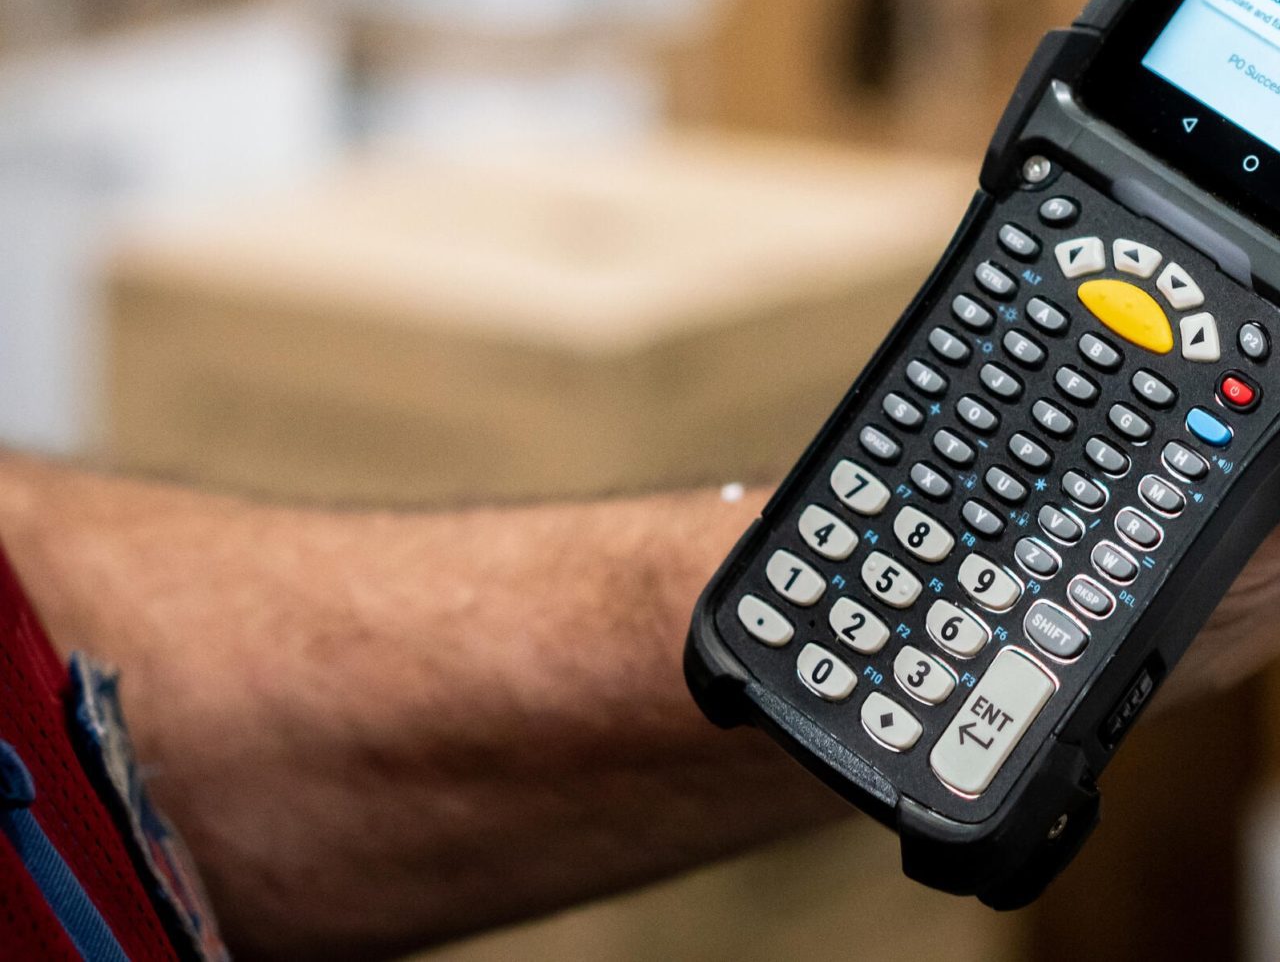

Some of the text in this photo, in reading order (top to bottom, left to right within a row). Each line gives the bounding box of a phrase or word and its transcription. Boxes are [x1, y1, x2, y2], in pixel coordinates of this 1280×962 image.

[1253, 9, 1273, 24] and
[1227, 53, 1247, 70] PO
[1048, 199, 1064, 215] P1
[1006, 231, 1025, 249] ESC
[981, 268, 1003, 289] CTRL
[1021, 269, 1042, 285] ALT
[964, 304, 977, 318] D
[1036, 307, 1050, 323] A
[1014, 339, 1028, 355] E
[1090, 341, 1103, 357] B
[1243, 332, 1259, 349] P2
[917, 369, 932, 386] N
[990, 373, 1005, 388] J
[1066, 375, 1081, 389] F
[1143, 379, 1157, 394] C
[894, 402, 908, 418] S
[1042, 408, 1058, 425] K
[1120, 413, 1133, 428] G
[865, 431, 890, 454] SPACE
[946, 437, 960, 453] T
[1019, 441, 1034, 455] P
[1096, 446, 1107, 462] L
[1173, 449, 1189, 466] H
[844, 473, 870, 499] 7
[921, 470, 937, 488] X
[997, 475, 1011, 491] U
[1073, 479, 1087, 496] Q
[896, 484, 912, 499] F7
[1148, 483, 1166, 502] M
[975, 507, 990, 523] Y
[1050, 512, 1064, 528] V
[813, 523, 836, 547] 4
[907, 521, 931, 549] 8
[1126, 518, 1141, 535] R
[863, 529, 879, 545] F4
[961, 531, 976, 547] F8
[1025, 546, 1041, 563] Z
[1102, 551, 1119, 569] W
[783, 567, 802, 592] 1
[831, 574, 846, 589] F1
[875, 565, 900, 594] 5
[928, 577, 944, 593] F5
[973, 568, 996, 594] 9
[1026, 579, 1041, 594] F9
[1074, 584, 1100, 605] BKSP
[1118, 589, 1136, 609] DEL
[841, 612, 866, 642] 2
[895, 623, 911, 639] F2
[940, 616, 964, 642] 6
[993, 626, 1008, 641] F6
[1031, 613, 1072, 646] SHIFT
[811, 658, 834, 685] 0
[863, 665, 883, 685] F10
[906, 660, 931, 688] 3
[960, 672, 977, 688] F3
[970, 695, 1014, 732] ENT
